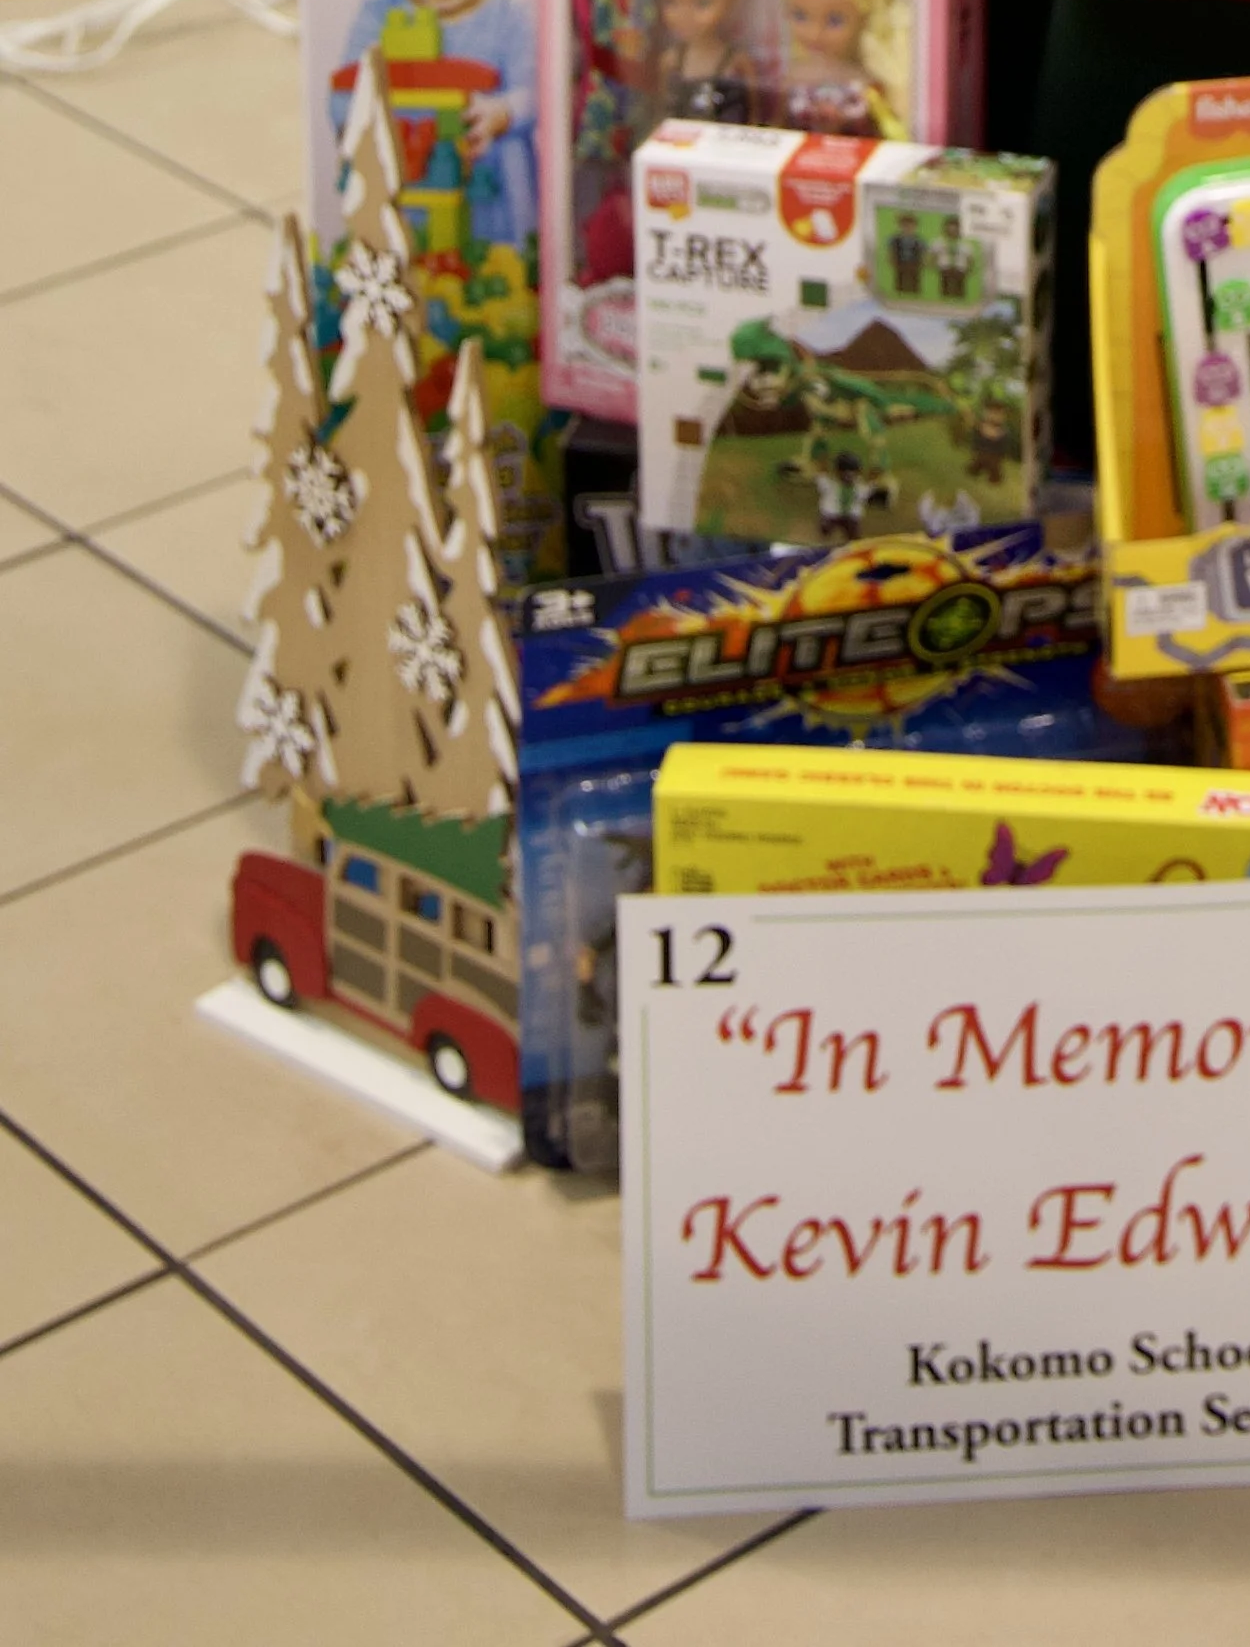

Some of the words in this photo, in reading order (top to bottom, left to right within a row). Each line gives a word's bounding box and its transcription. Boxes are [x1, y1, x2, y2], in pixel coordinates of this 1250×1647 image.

[646, 263, 769, 292] CAPTURE
[649, 228, 766, 267] T-REX
[619, 608, 910, 697] ELITE
[650, 924, 738, 988] 12
[681, 1189, 989, 1283] Kevin
[908, 1341, 1114, 1389] Kokomo
[828, 1398, 1185, 1462] Transportation
